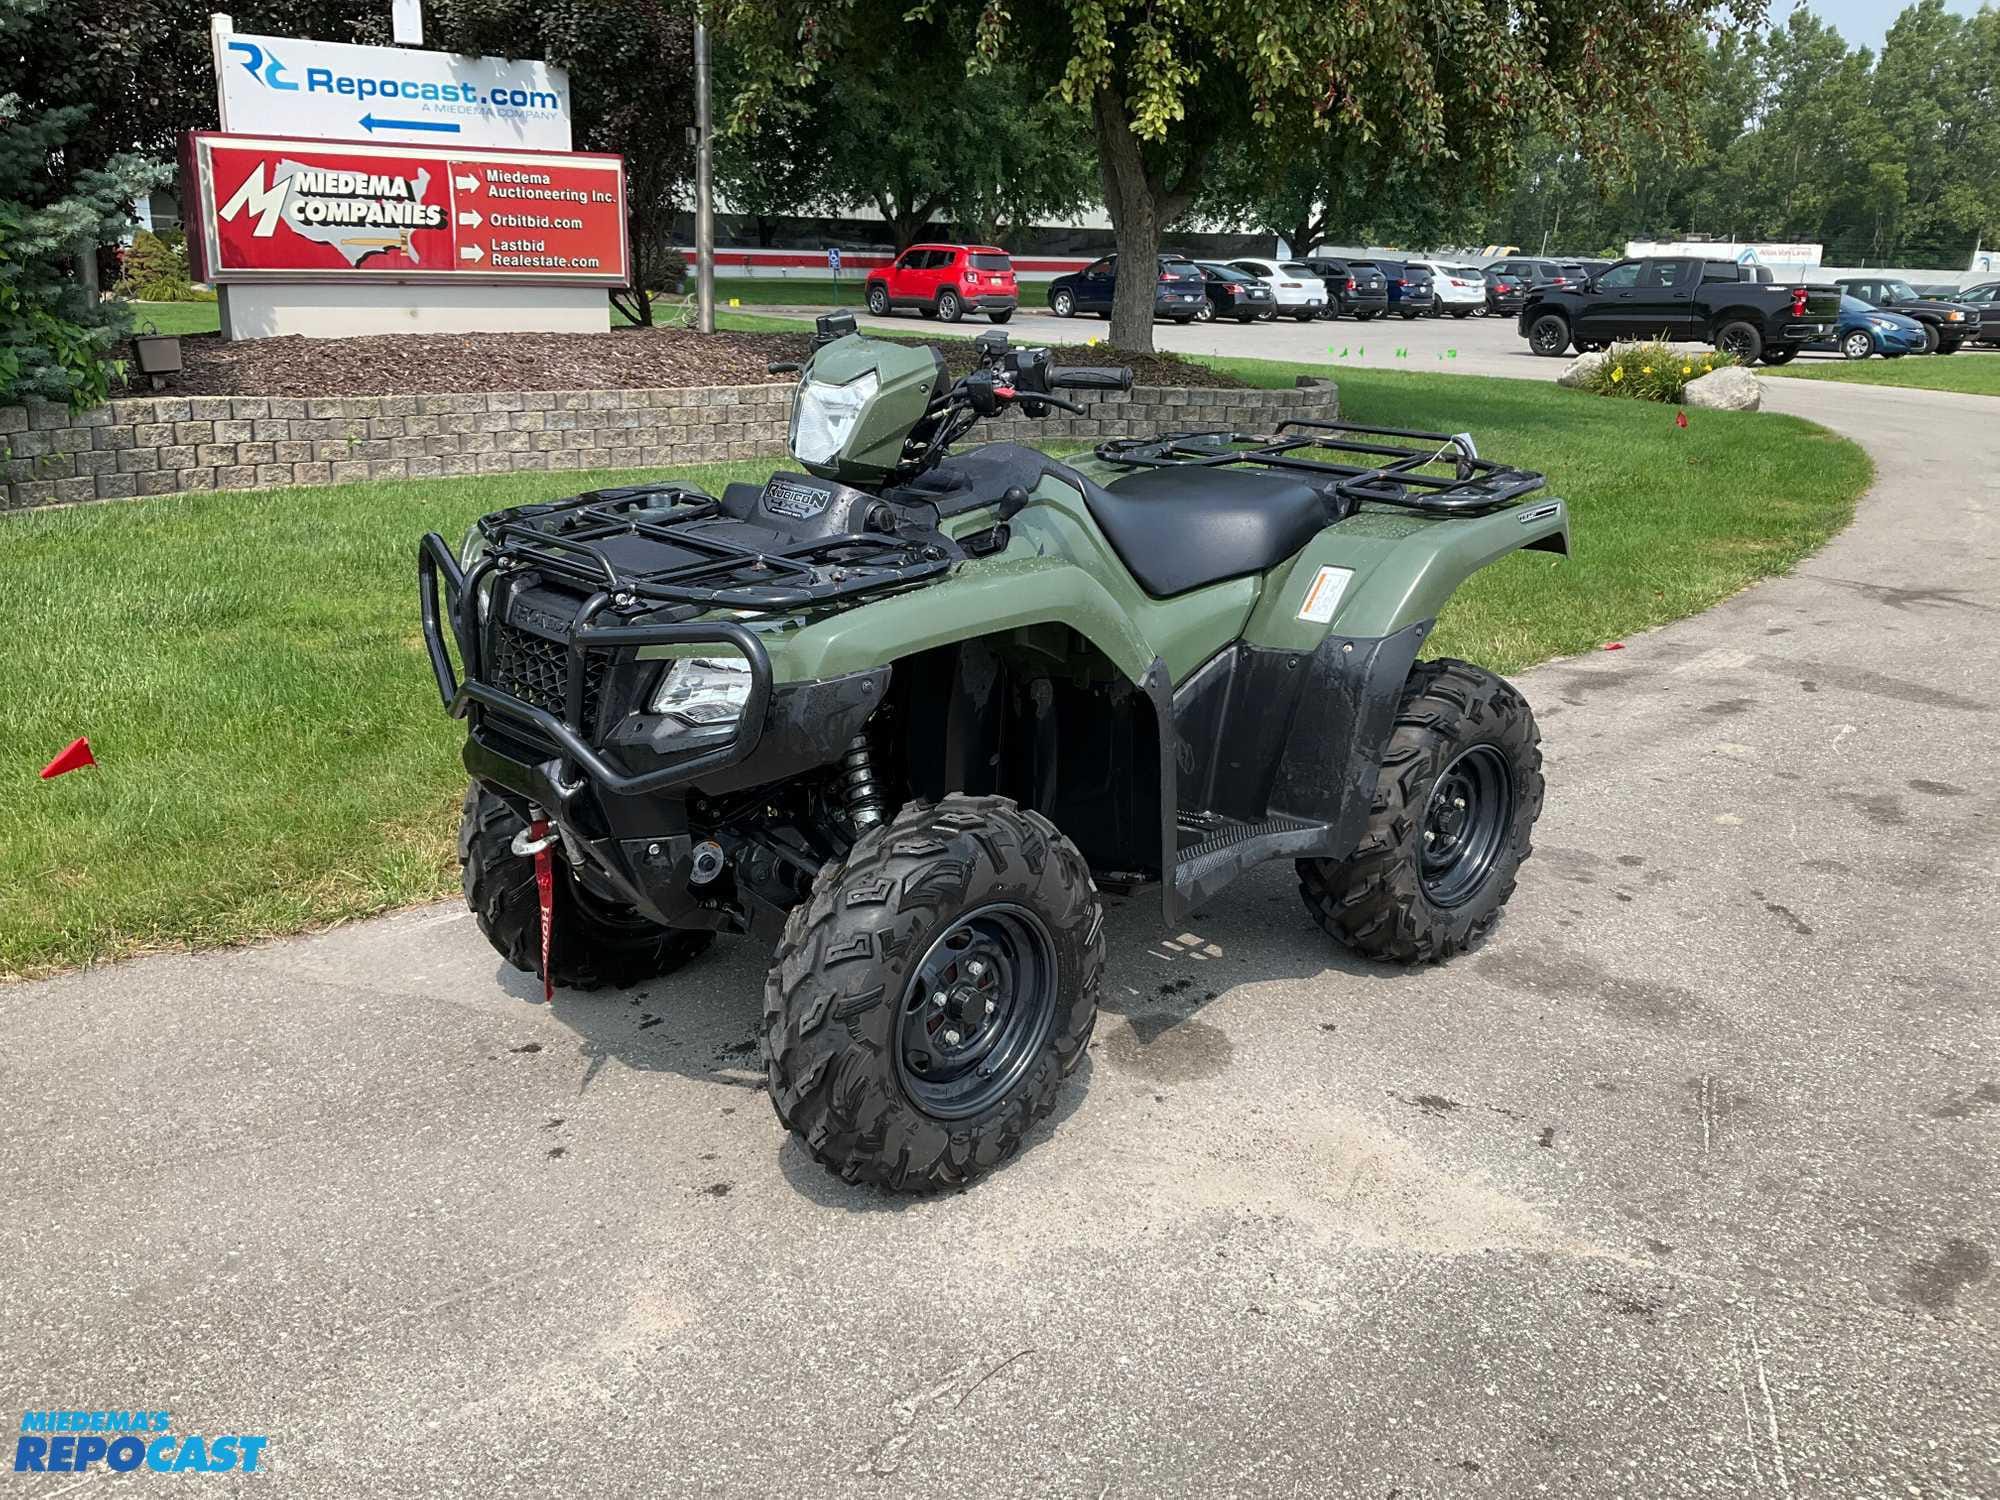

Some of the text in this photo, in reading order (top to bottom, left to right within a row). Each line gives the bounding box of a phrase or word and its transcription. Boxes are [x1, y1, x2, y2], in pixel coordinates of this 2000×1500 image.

[307, 67, 558, 109] Repocast.com
[422, 103, 559, 120] A MIEDEMA COMPANY
[296, 171, 409, 198] MIEDEMA
[486, 169, 551, 185] Miedema
[488, 185, 617, 205] Auctioneering Inc.
[290, 202, 441, 226] COMPANIES
[490, 213, 583, 229] Orbitbid.com
[491, 238, 545, 252] Lastbid
[492, 253, 599, 268] Realestate.com
